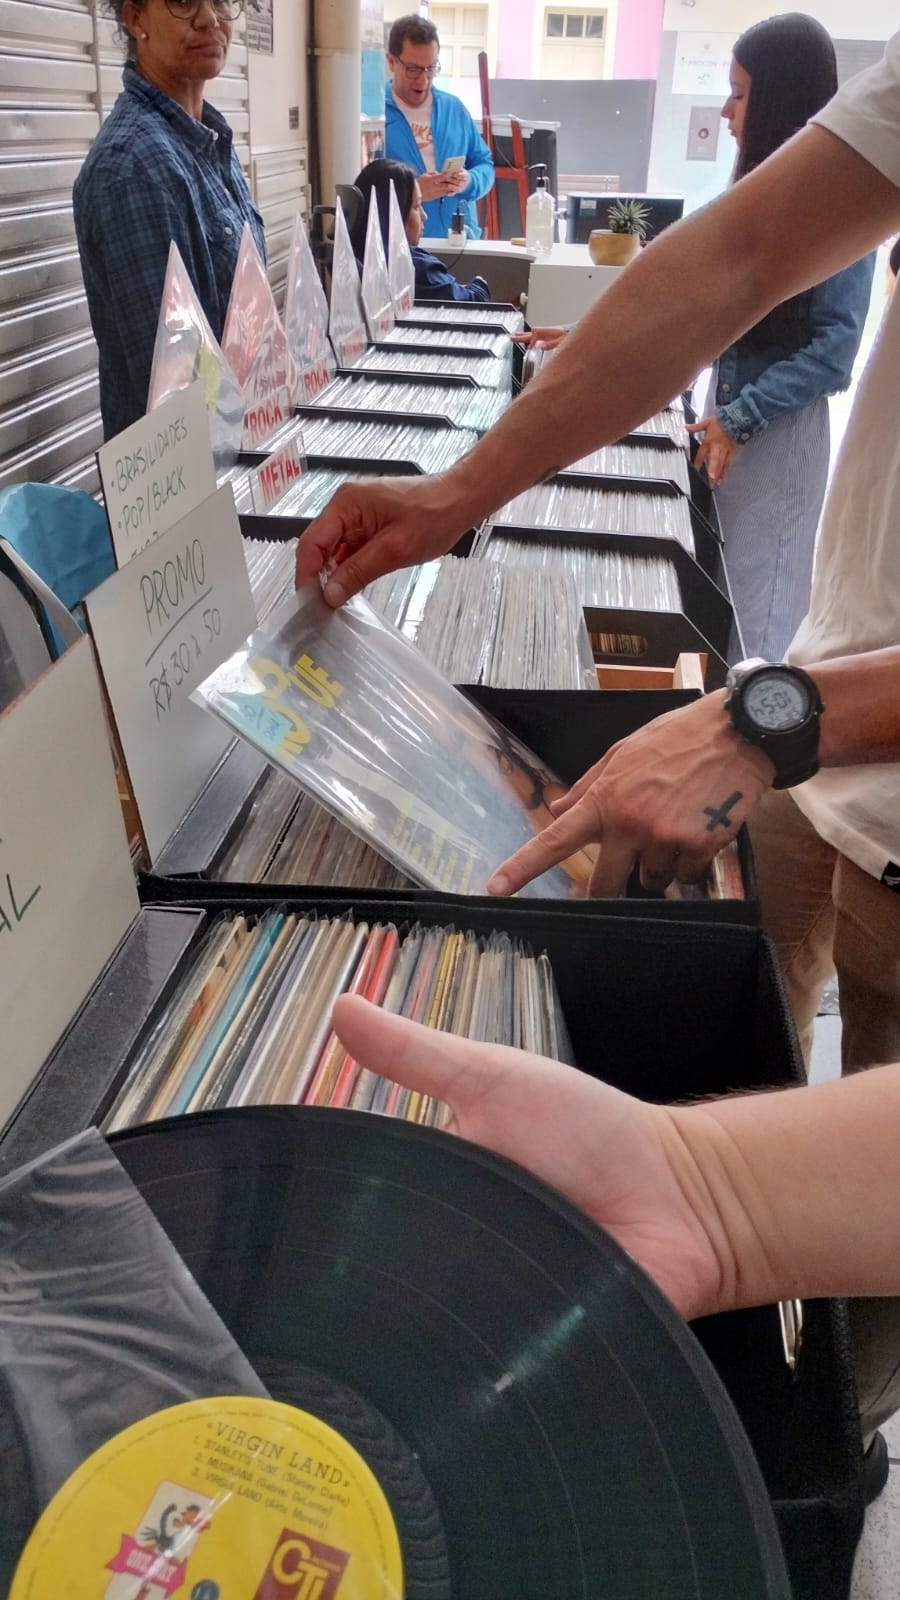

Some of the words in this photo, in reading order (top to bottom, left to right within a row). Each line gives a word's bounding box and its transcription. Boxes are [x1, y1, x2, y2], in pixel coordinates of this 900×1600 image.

[249, 397, 283, 445] ROCK
[259, 443, 301, 506] METAL
[139, 538, 206, 636] PROMO
[202, 607, 221, 643] 50
[215, 1421, 286, 1460] VIRGIN
